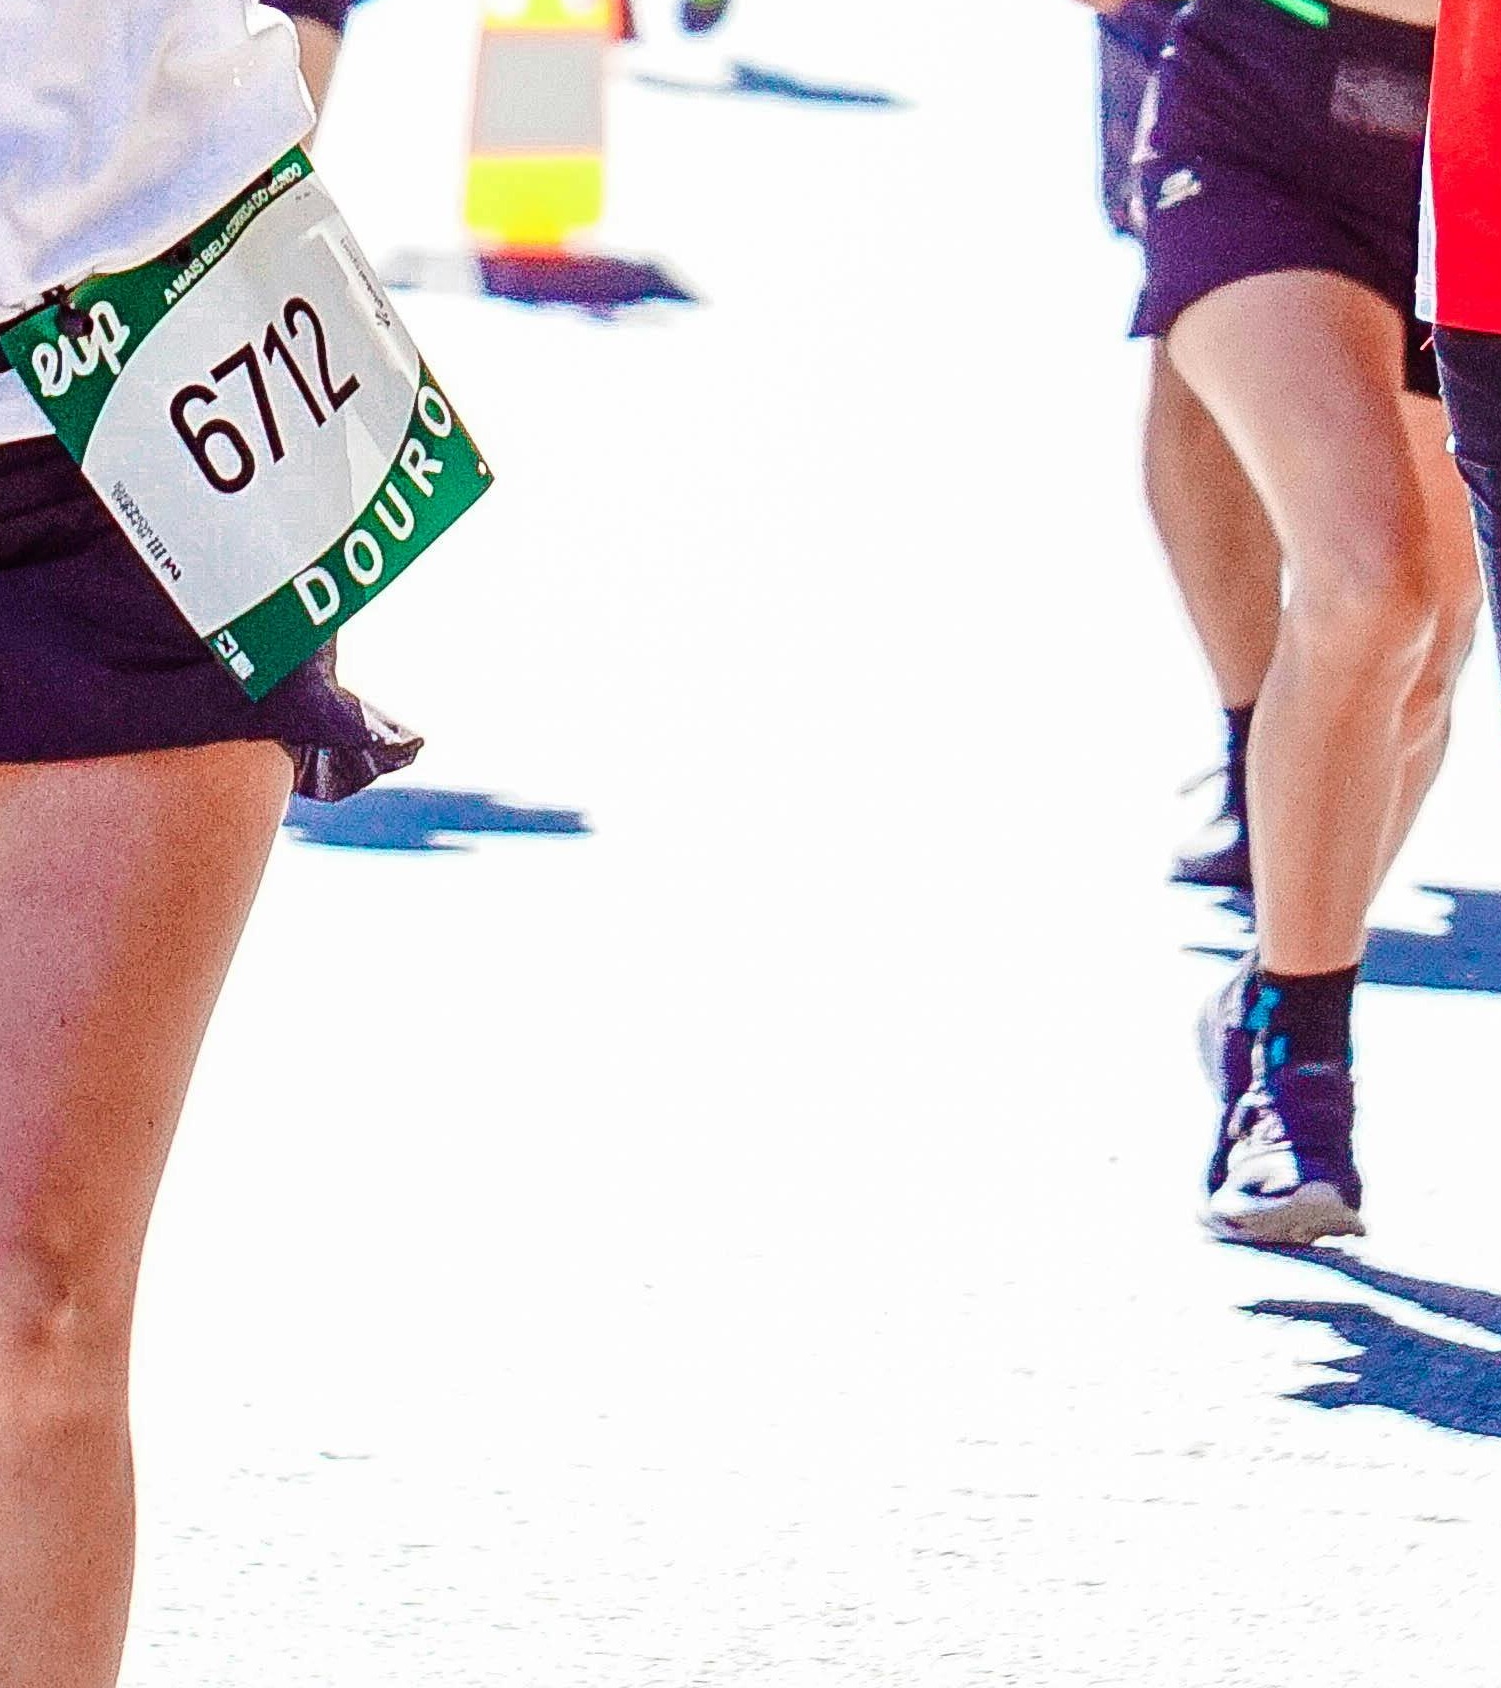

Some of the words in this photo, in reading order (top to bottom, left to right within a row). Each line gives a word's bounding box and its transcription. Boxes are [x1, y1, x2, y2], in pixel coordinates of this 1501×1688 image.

[164, 288, 177, 305] A
[172, 257, 205, 294] MAIS
[200, 232, 231, 266] BELA
[169, 297, 361, 495] 6712
[294, 384, 452, 626] DOURO
